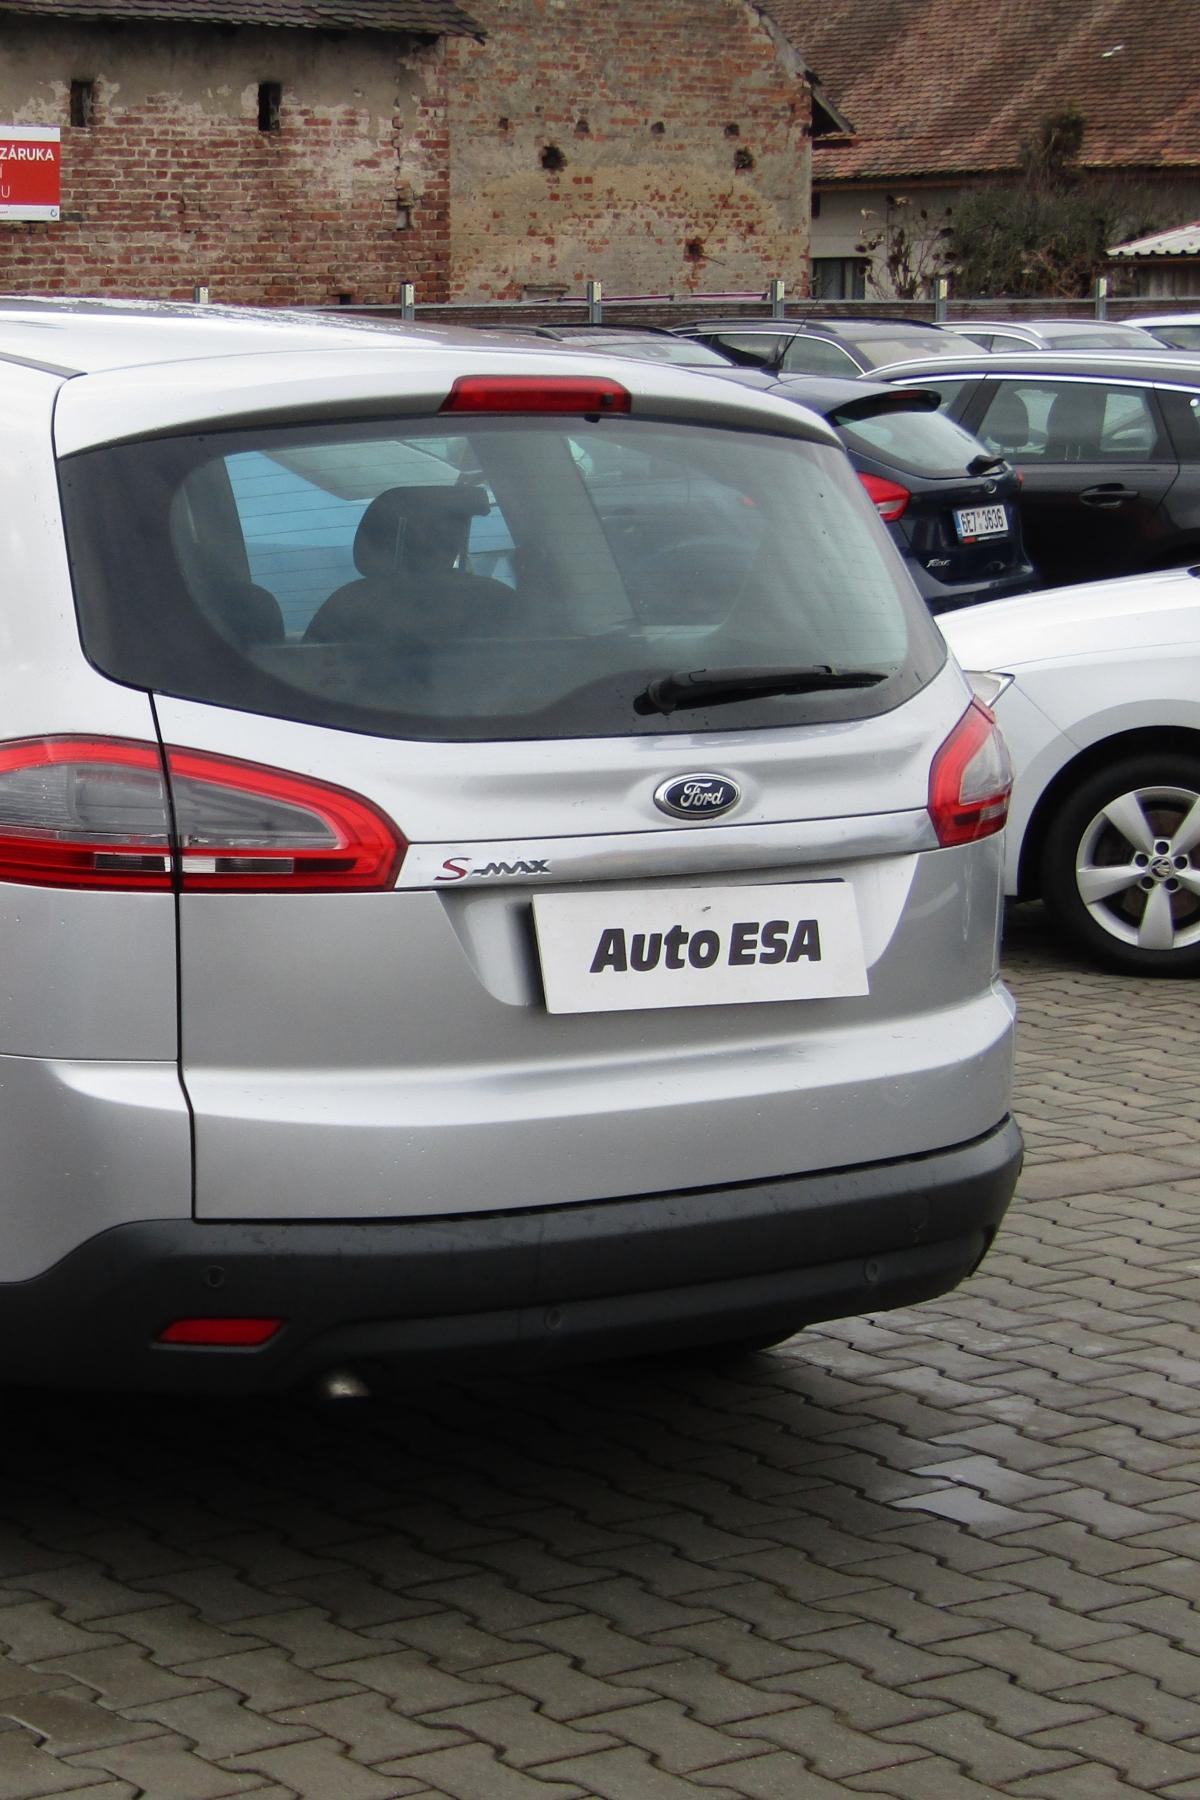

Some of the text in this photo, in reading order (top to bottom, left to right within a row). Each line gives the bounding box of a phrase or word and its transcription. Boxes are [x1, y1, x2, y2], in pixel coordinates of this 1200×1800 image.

[0, 144, 55, 161] ZÁRUKA
[960, 507, 1004, 533] 6E7 3636
[680, 782, 725, 807] Ford
[433, 857, 552, 881] S-MAX
[589, 918, 822, 974] Auto ESA
